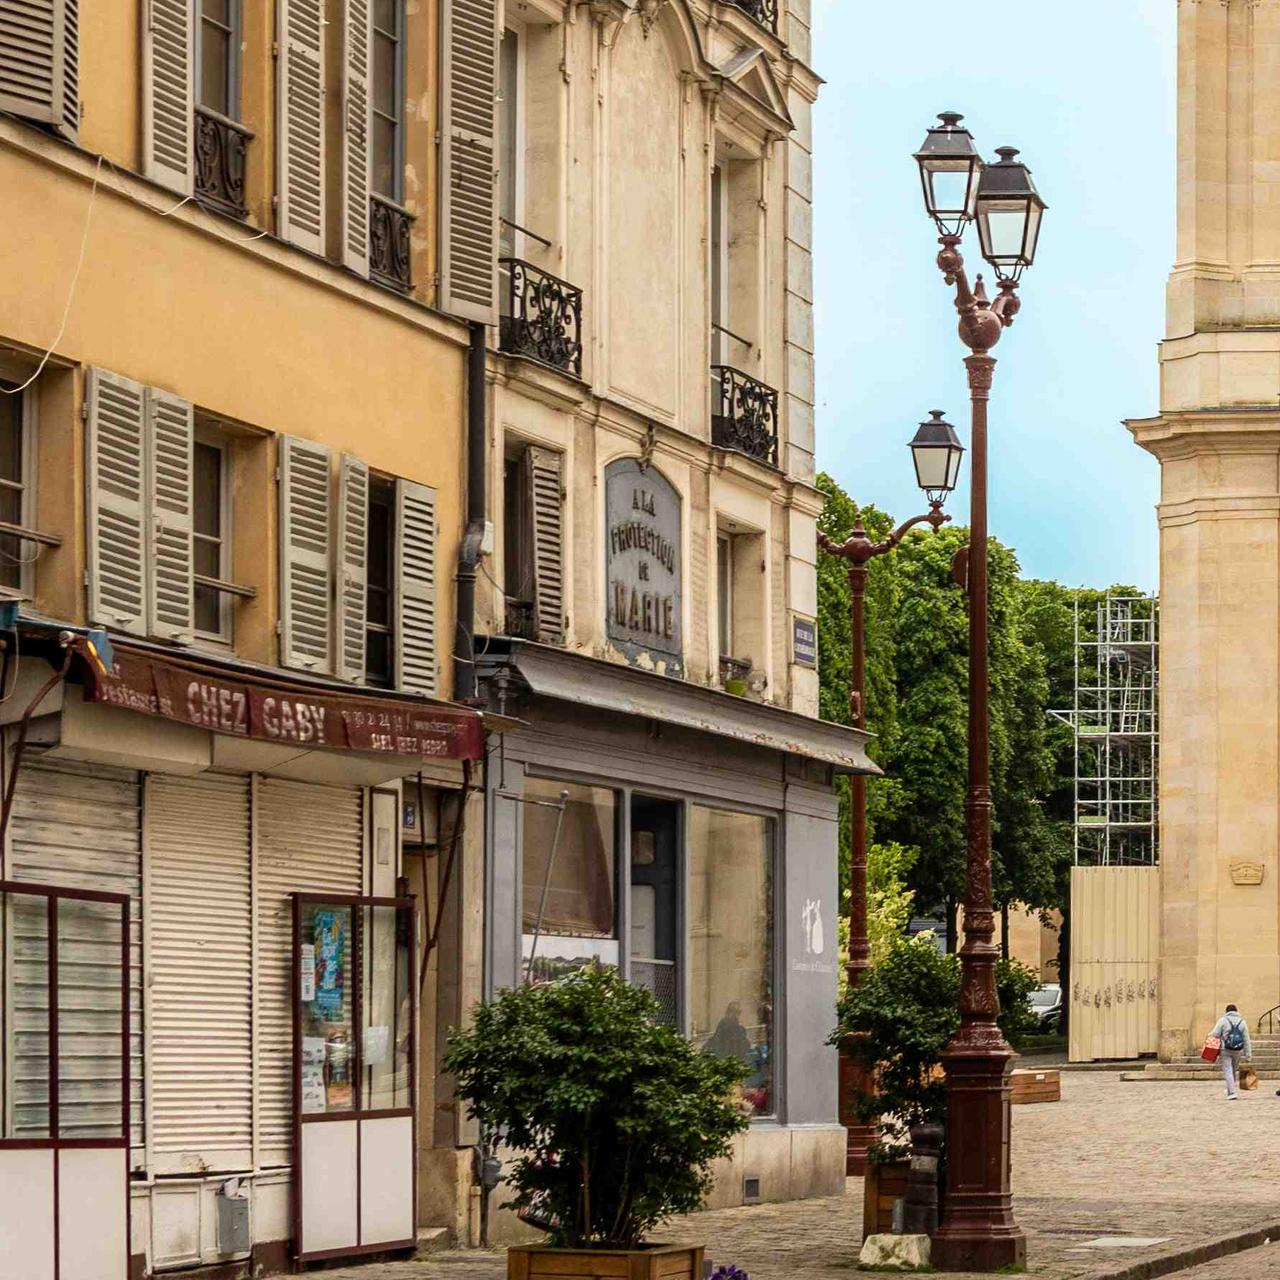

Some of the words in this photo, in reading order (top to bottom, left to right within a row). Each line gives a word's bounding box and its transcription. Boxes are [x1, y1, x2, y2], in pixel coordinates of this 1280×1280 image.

[611, 522, 675, 576] PROTECTION
[638, 560, 650, 582] DE
[613, 580, 673, 640] MARIE
[187, 682, 247, 734] CHEZ
[263, 697, 325, 744] GABY
